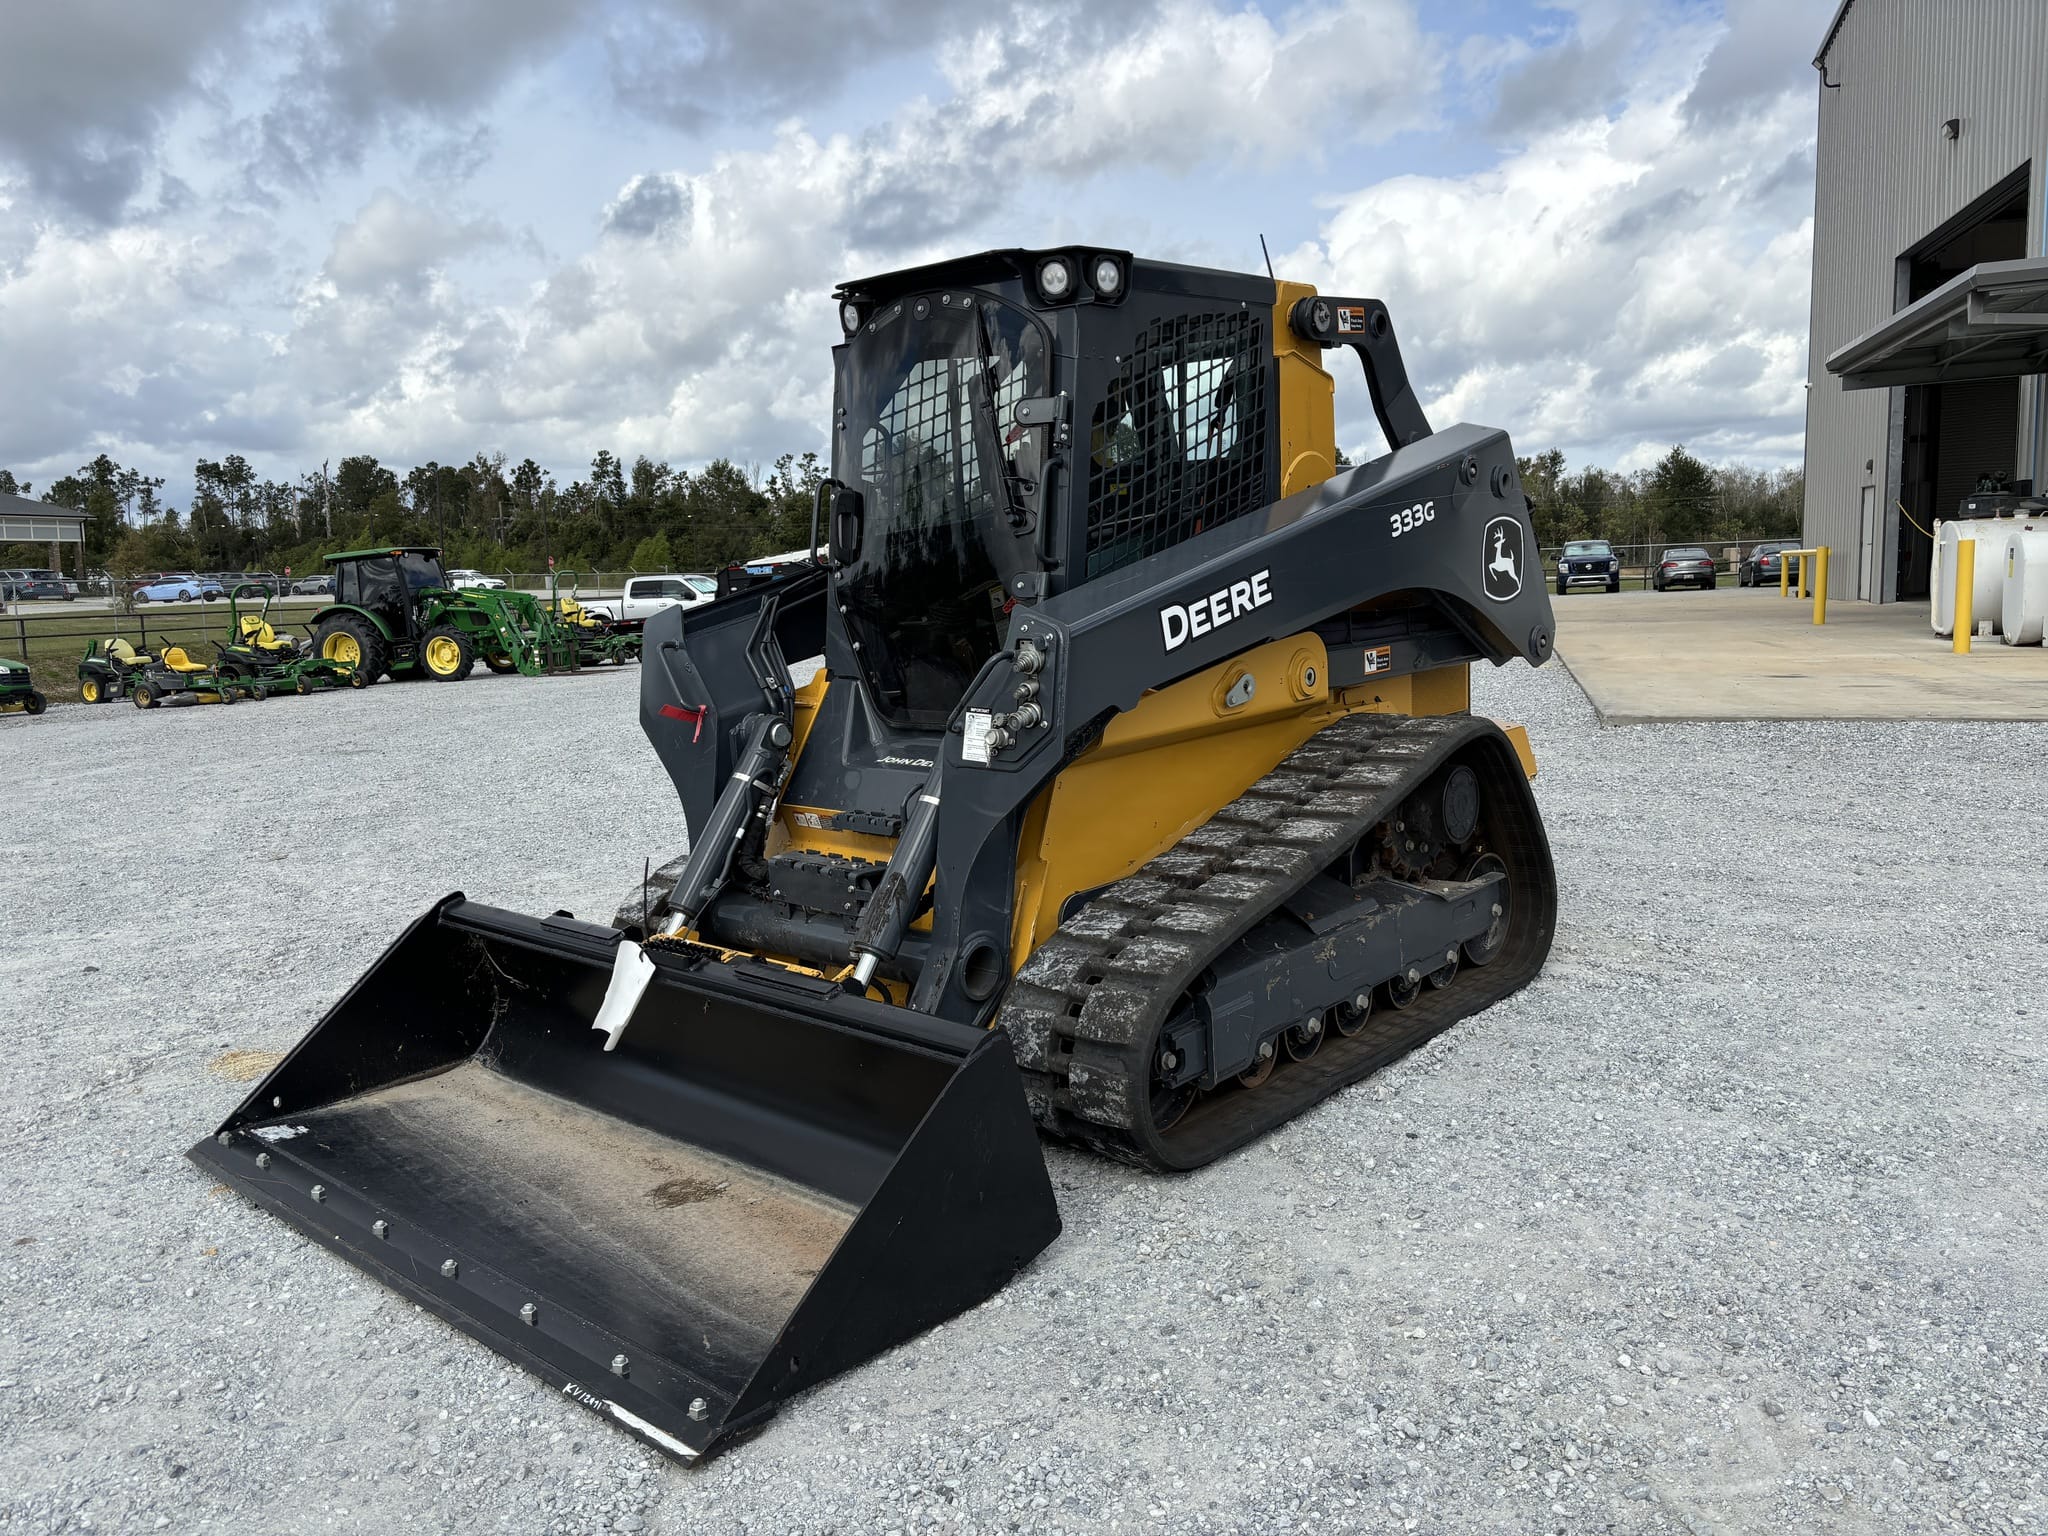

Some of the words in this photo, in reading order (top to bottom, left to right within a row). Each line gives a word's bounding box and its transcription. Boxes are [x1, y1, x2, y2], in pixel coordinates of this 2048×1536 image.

[1390, 501, 1435, 538] 333G
[1160, 569, 1273, 651] DEERE
[875, 755, 914, 766] JOHN
